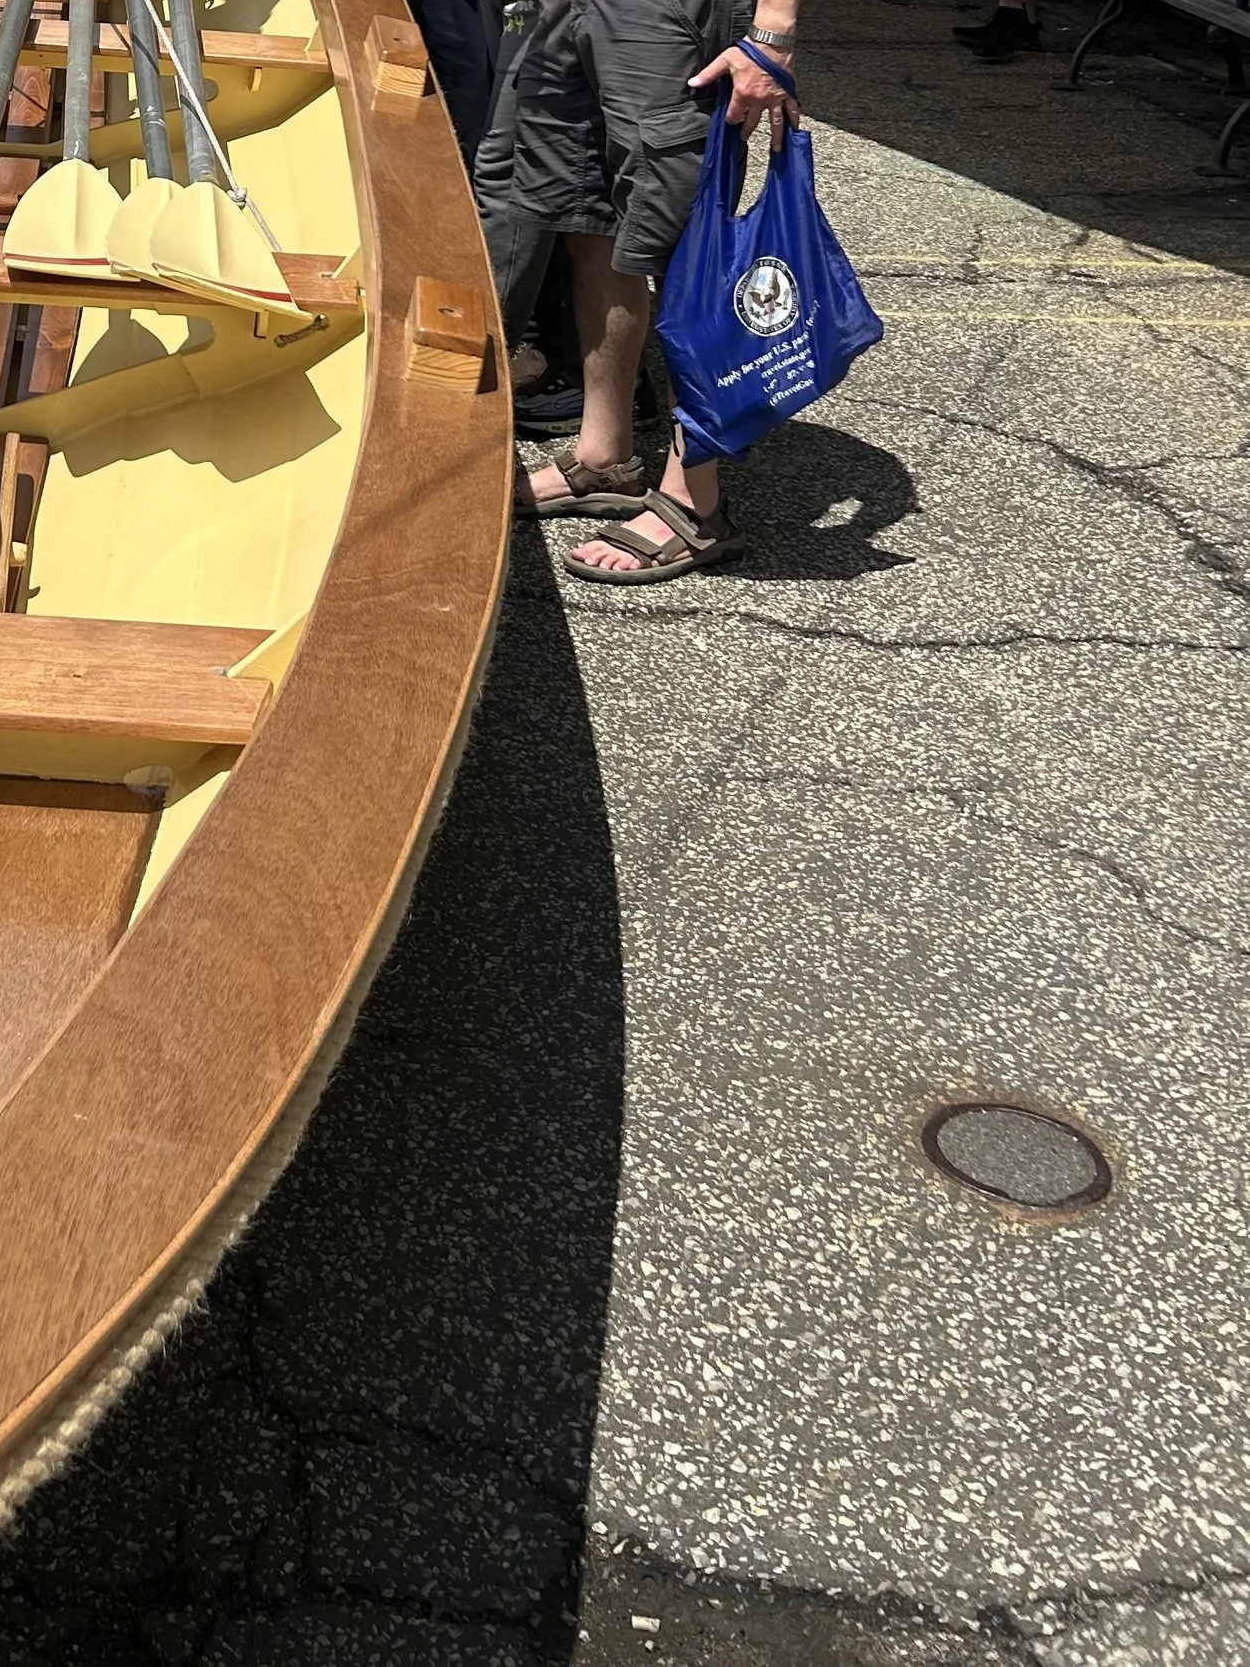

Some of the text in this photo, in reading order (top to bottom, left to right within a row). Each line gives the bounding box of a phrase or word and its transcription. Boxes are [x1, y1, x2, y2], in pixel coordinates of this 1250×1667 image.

[717, 369, 742, 388] Apply
[741, 362, 754, 374] for
[753, 352, 773, 369] your
